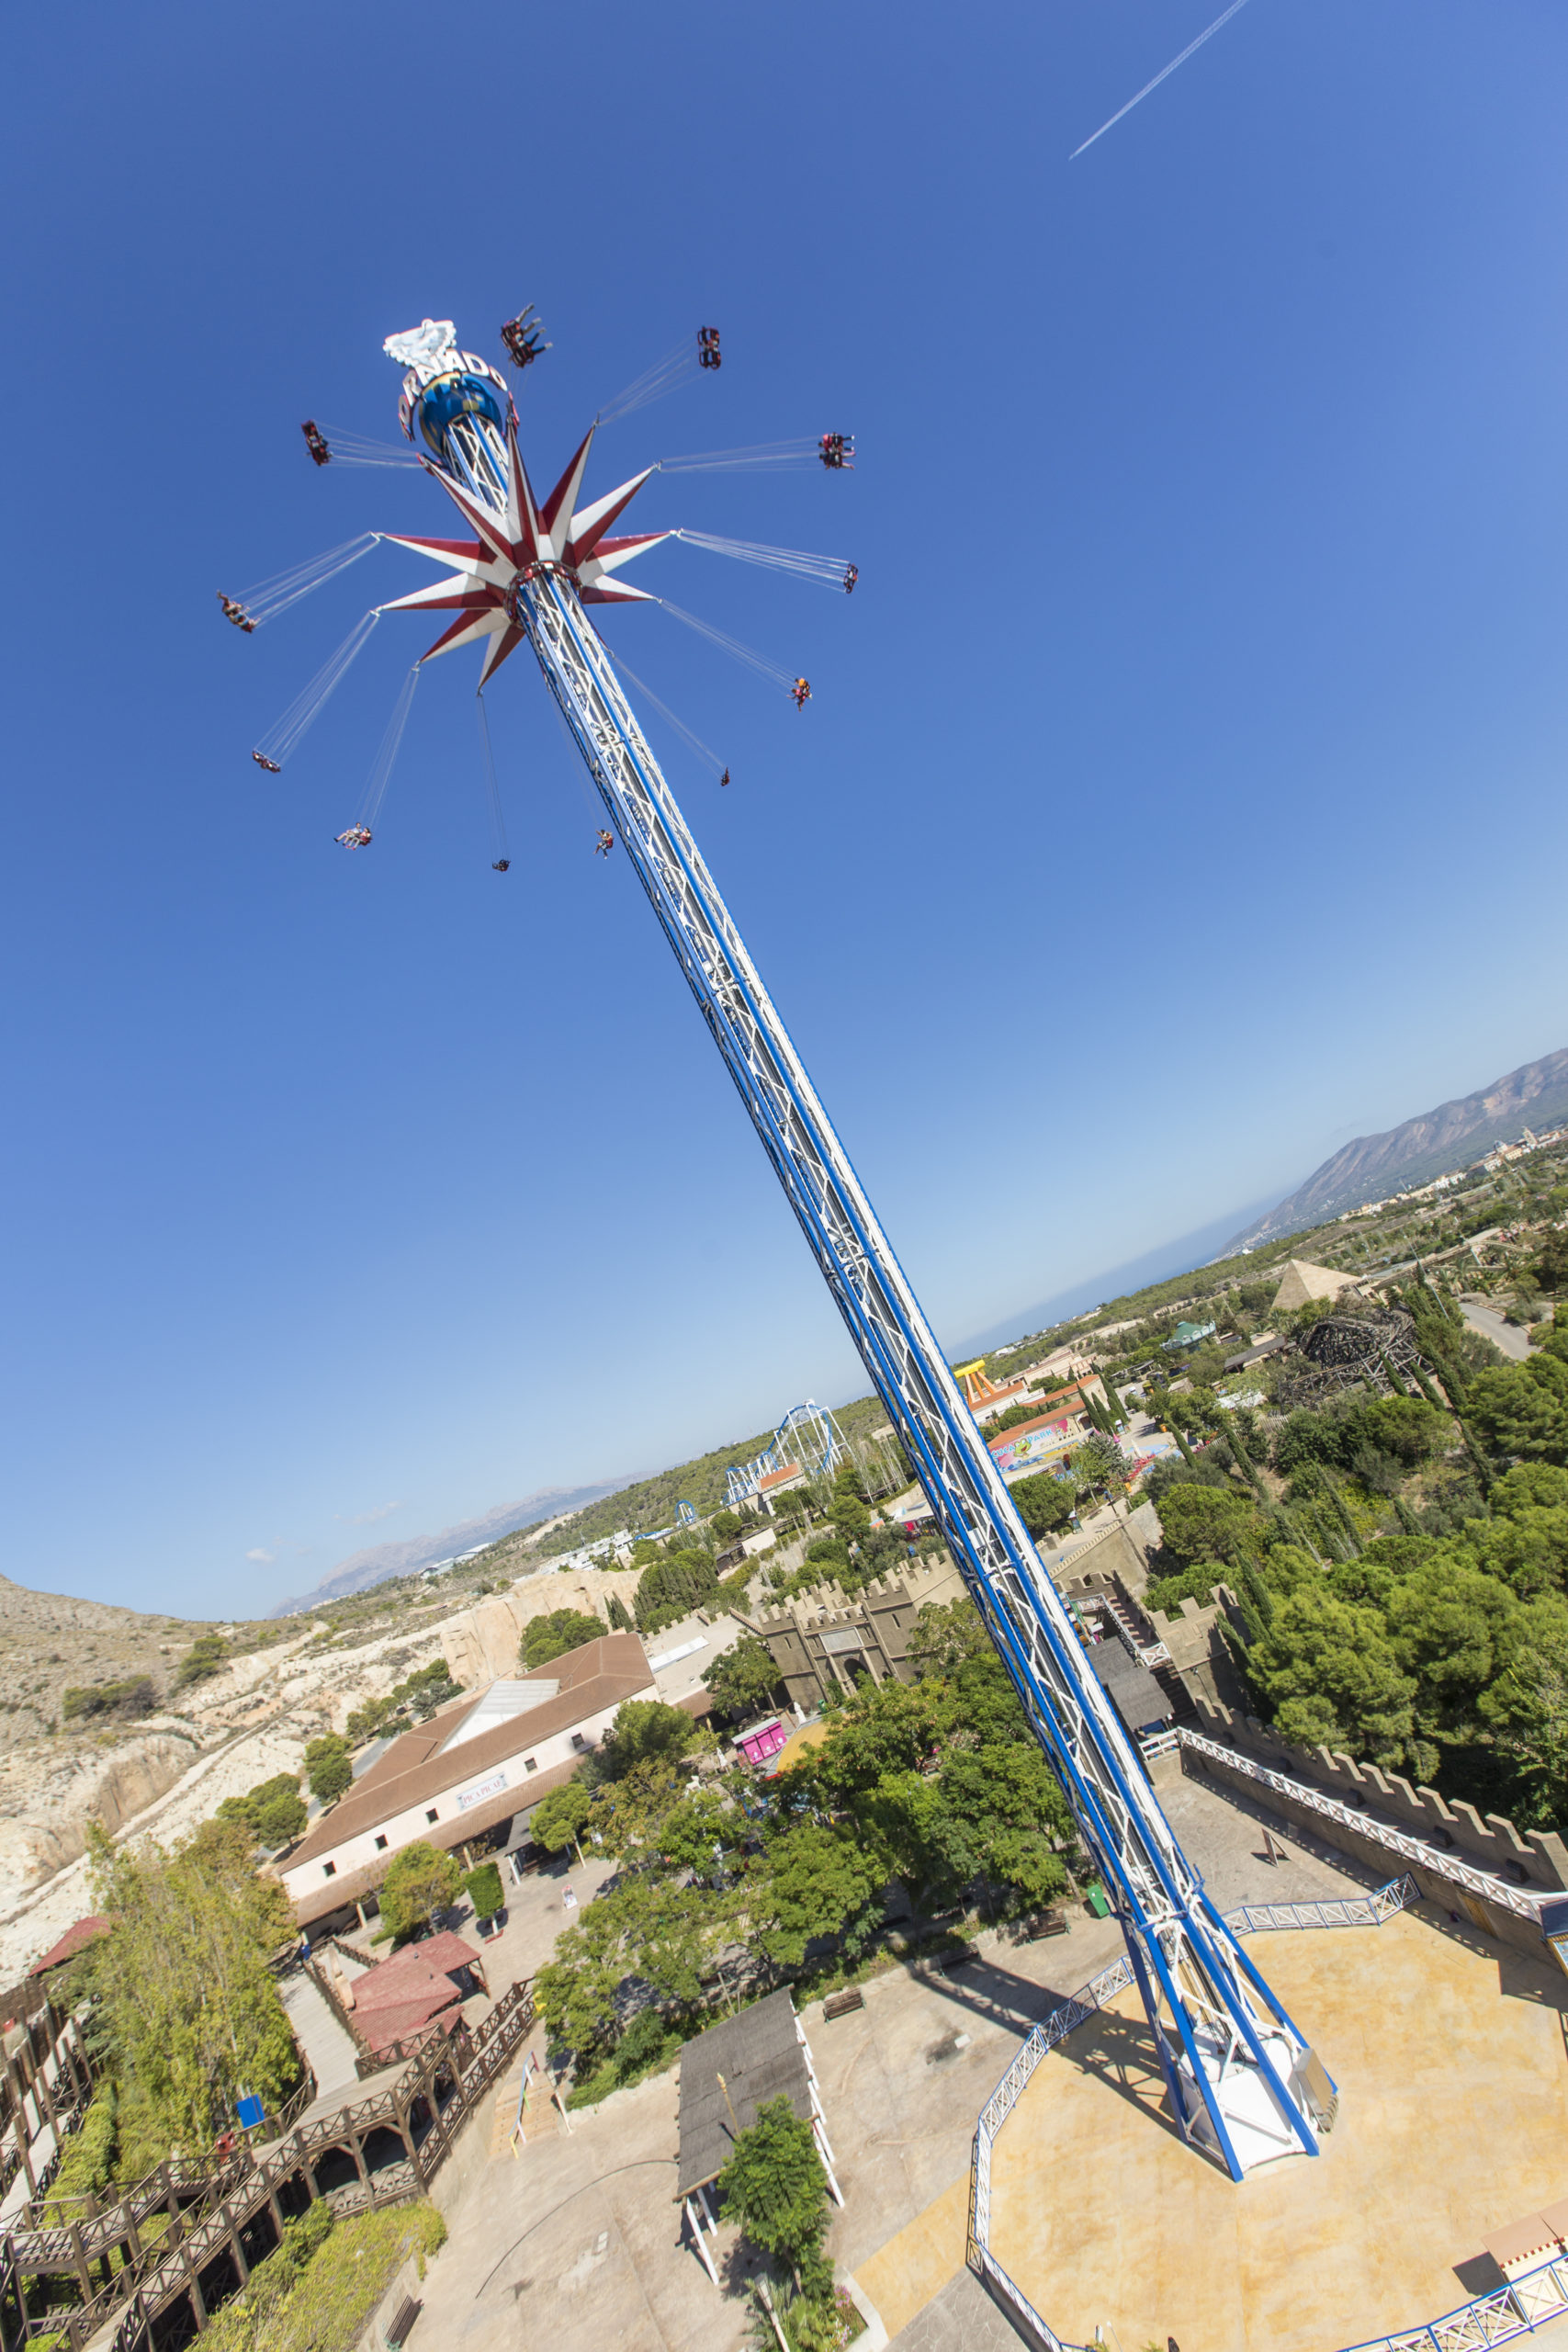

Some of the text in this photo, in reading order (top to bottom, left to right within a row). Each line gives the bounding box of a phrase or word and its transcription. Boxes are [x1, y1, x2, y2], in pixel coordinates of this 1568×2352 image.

[398, 347, 507, 441] ORNADO
[991, 1429, 1053, 1459] CUCA PARK
